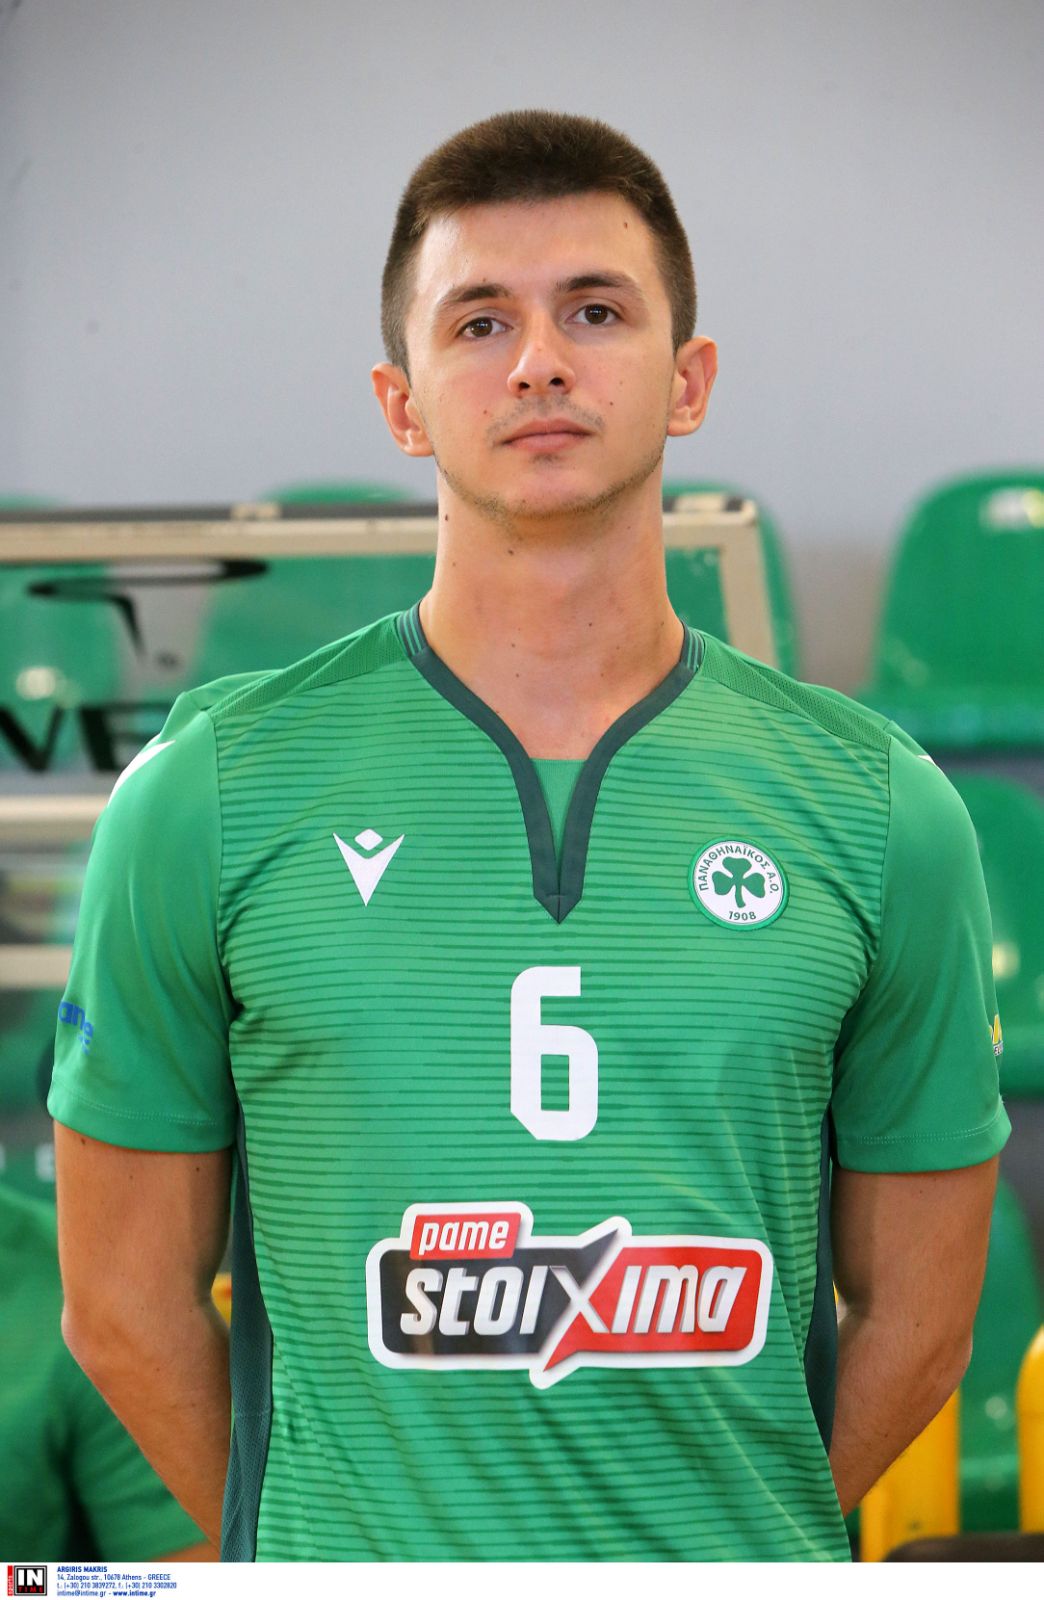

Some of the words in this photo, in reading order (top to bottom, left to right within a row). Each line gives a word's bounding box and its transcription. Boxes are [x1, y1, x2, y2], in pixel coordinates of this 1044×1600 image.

[728, 910, 757, 921] 1908
[510, 966, 598, 1141] 6
[418, 1220, 510, 1256] pame
